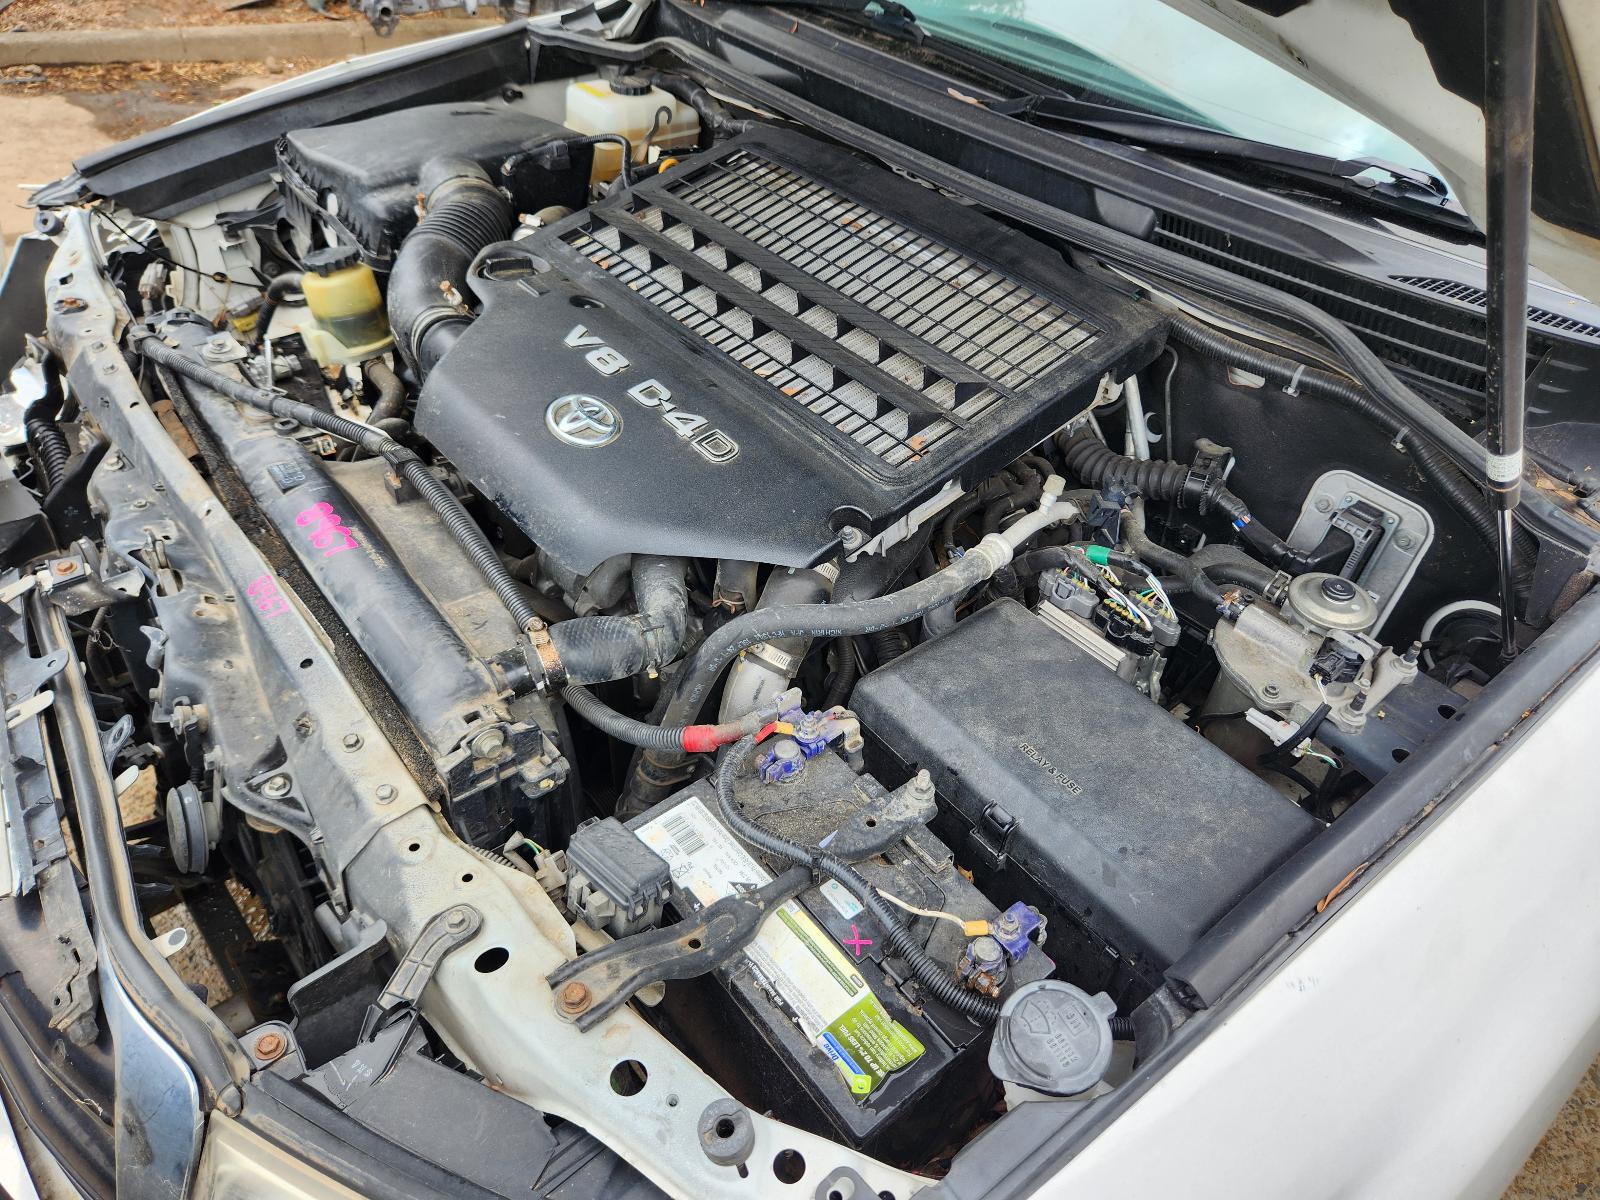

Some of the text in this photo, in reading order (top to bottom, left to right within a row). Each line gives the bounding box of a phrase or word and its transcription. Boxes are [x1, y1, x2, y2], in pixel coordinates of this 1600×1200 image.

[564, 324, 740, 462] V8 D-4D
[295, 501, 359, 557] 8967
[1019, 742, 1082, 796] RELAY & FUSE
[749, 963, 778, 996] MAINTENANCE
[773, 994, 784, 1006] FOR
[837, 1023, 851, 1037] FUEL
[846, 1033, 861, 1049] LESS
[821, 1042, 839, 1062] Drive
[863, 1053, 873, 1063] TO
[868, 1060, 879, 1071] UP
